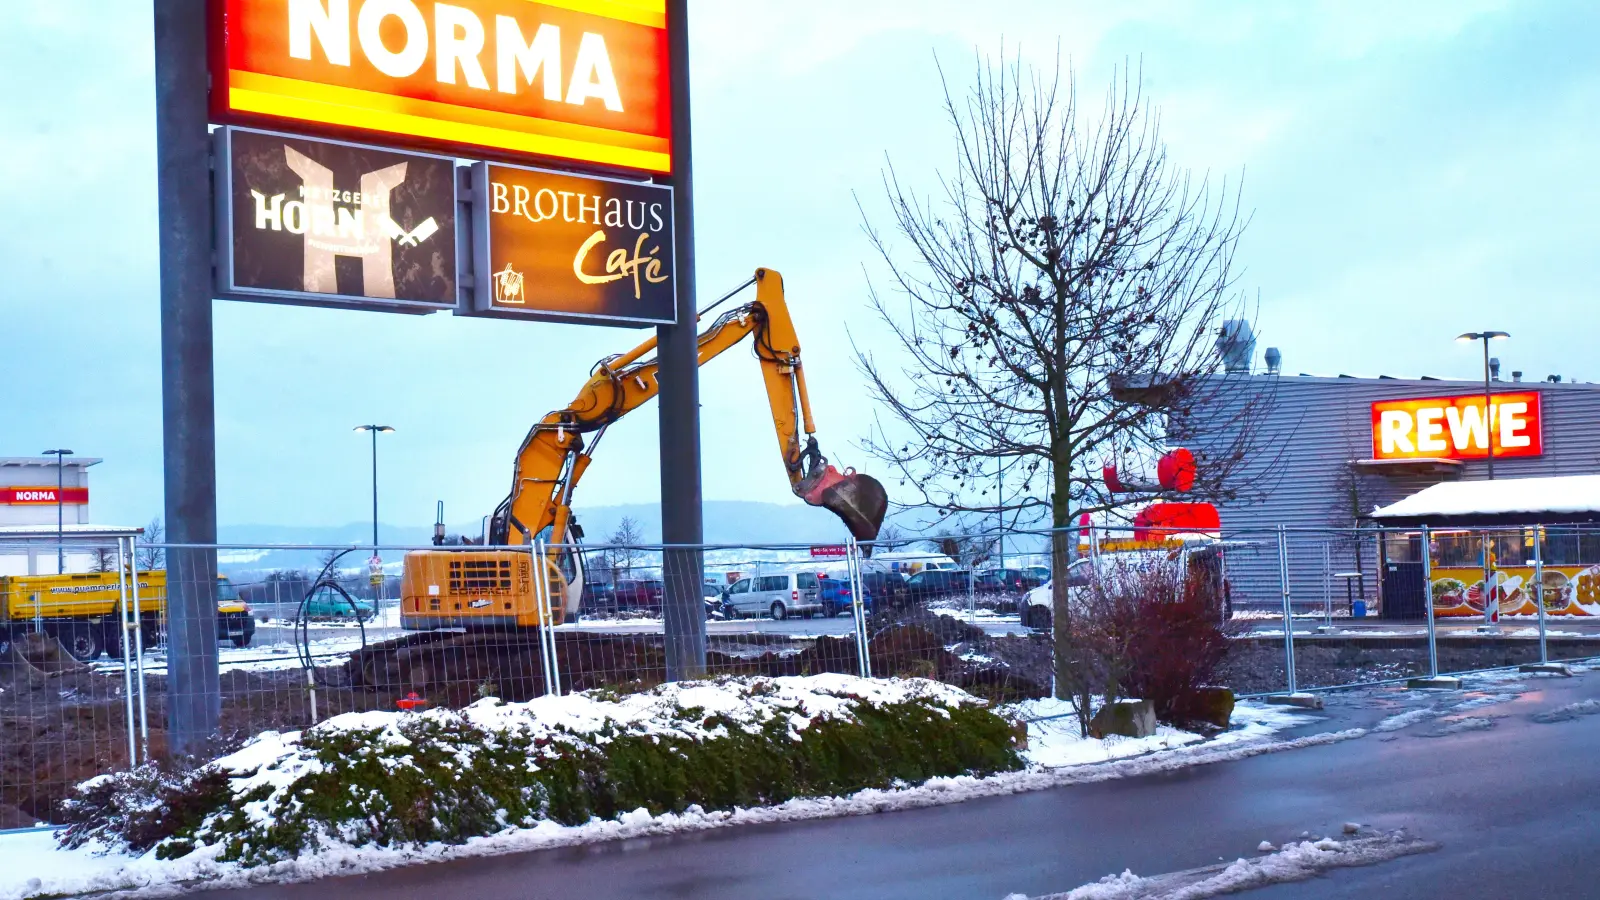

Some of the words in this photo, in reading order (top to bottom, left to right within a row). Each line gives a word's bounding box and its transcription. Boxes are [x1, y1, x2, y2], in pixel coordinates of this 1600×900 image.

[288, 0, 624, 113] NORMA
[250, 189, 365, 240] HORN
[573, 230, 669, 299] Café
[1380, 402, 1531, 454] REWE
[16, 491, 56, 501] NORMA
[449, 588, 512, 596] COMPACT
